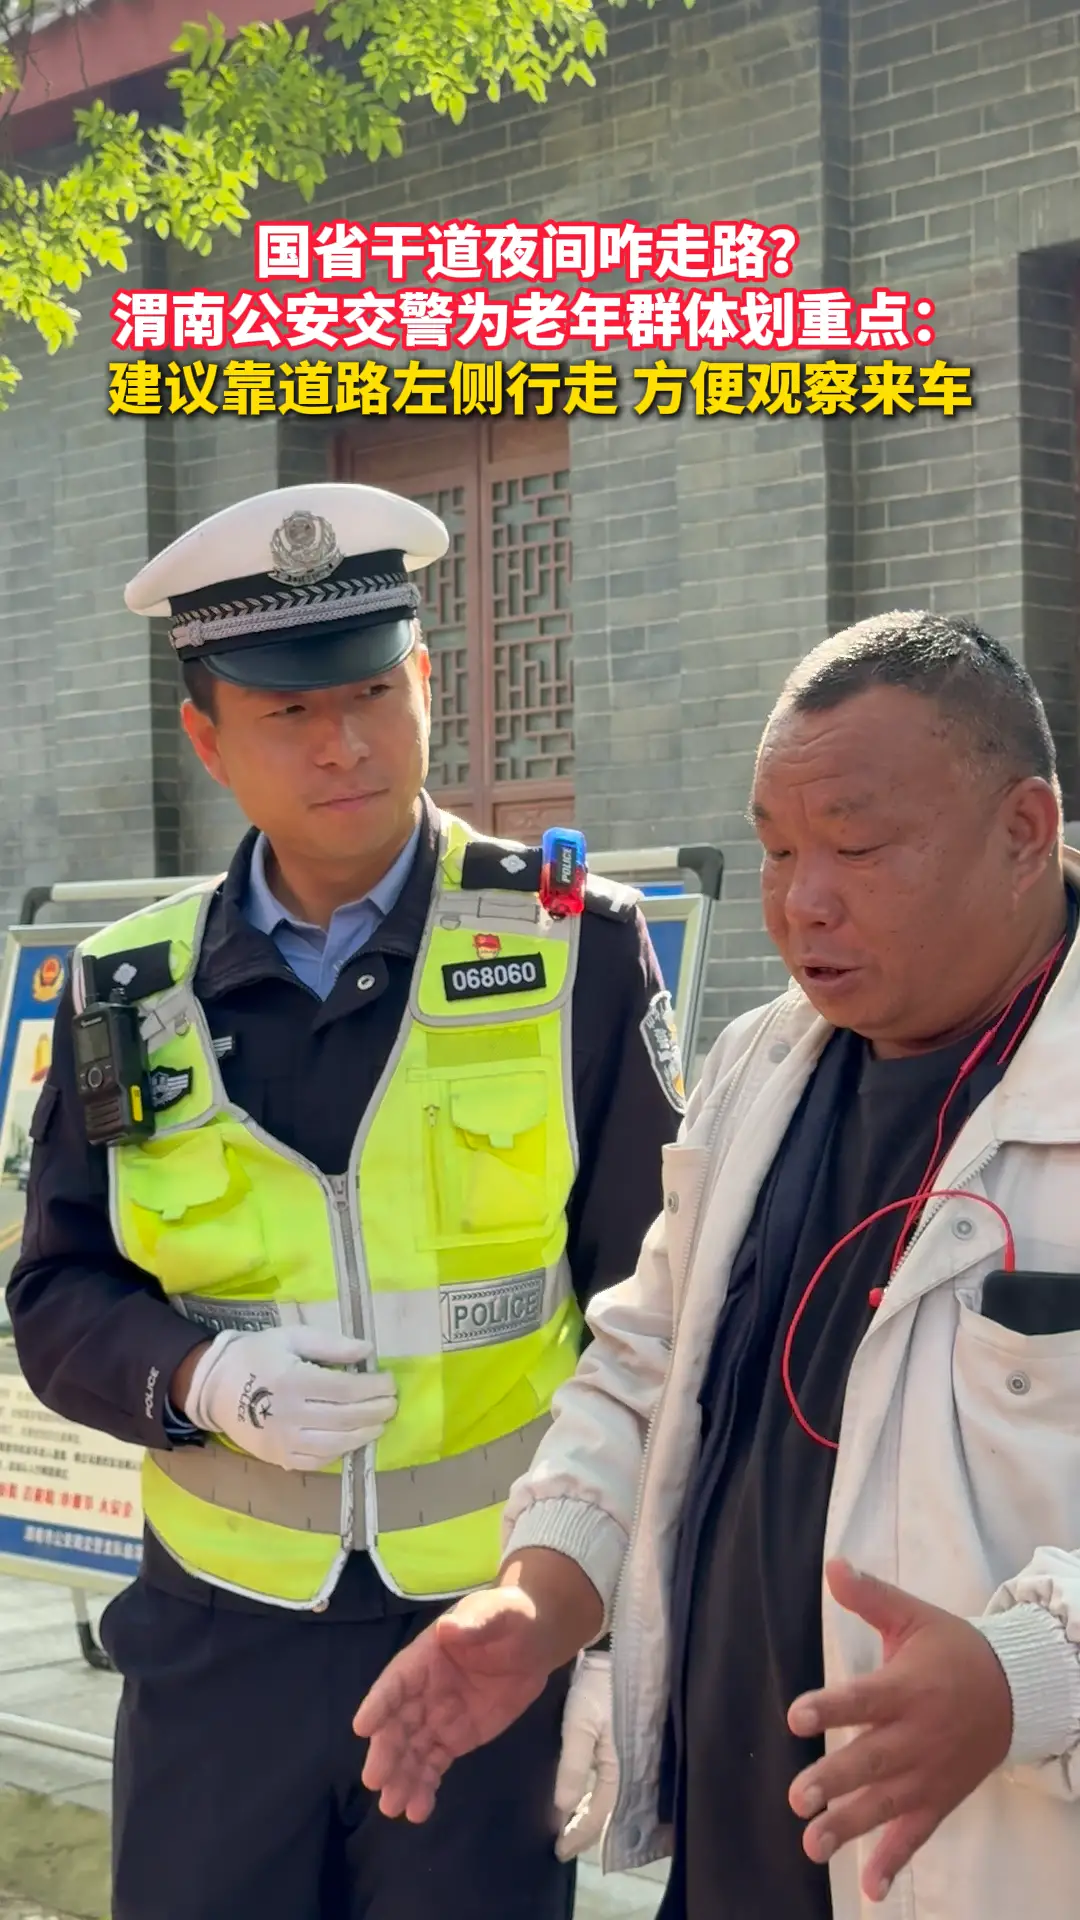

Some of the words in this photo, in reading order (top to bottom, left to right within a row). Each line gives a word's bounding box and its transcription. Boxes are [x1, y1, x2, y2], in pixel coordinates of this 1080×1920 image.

[561, 847, 572, 883] POLICE
[452, 961, 537, 991] 068060
[454, 1291, 539, 1330] POLICE
[145, 1366, 160, 1419] POLICE
[237, 1373, 256, 1422] POLICE
